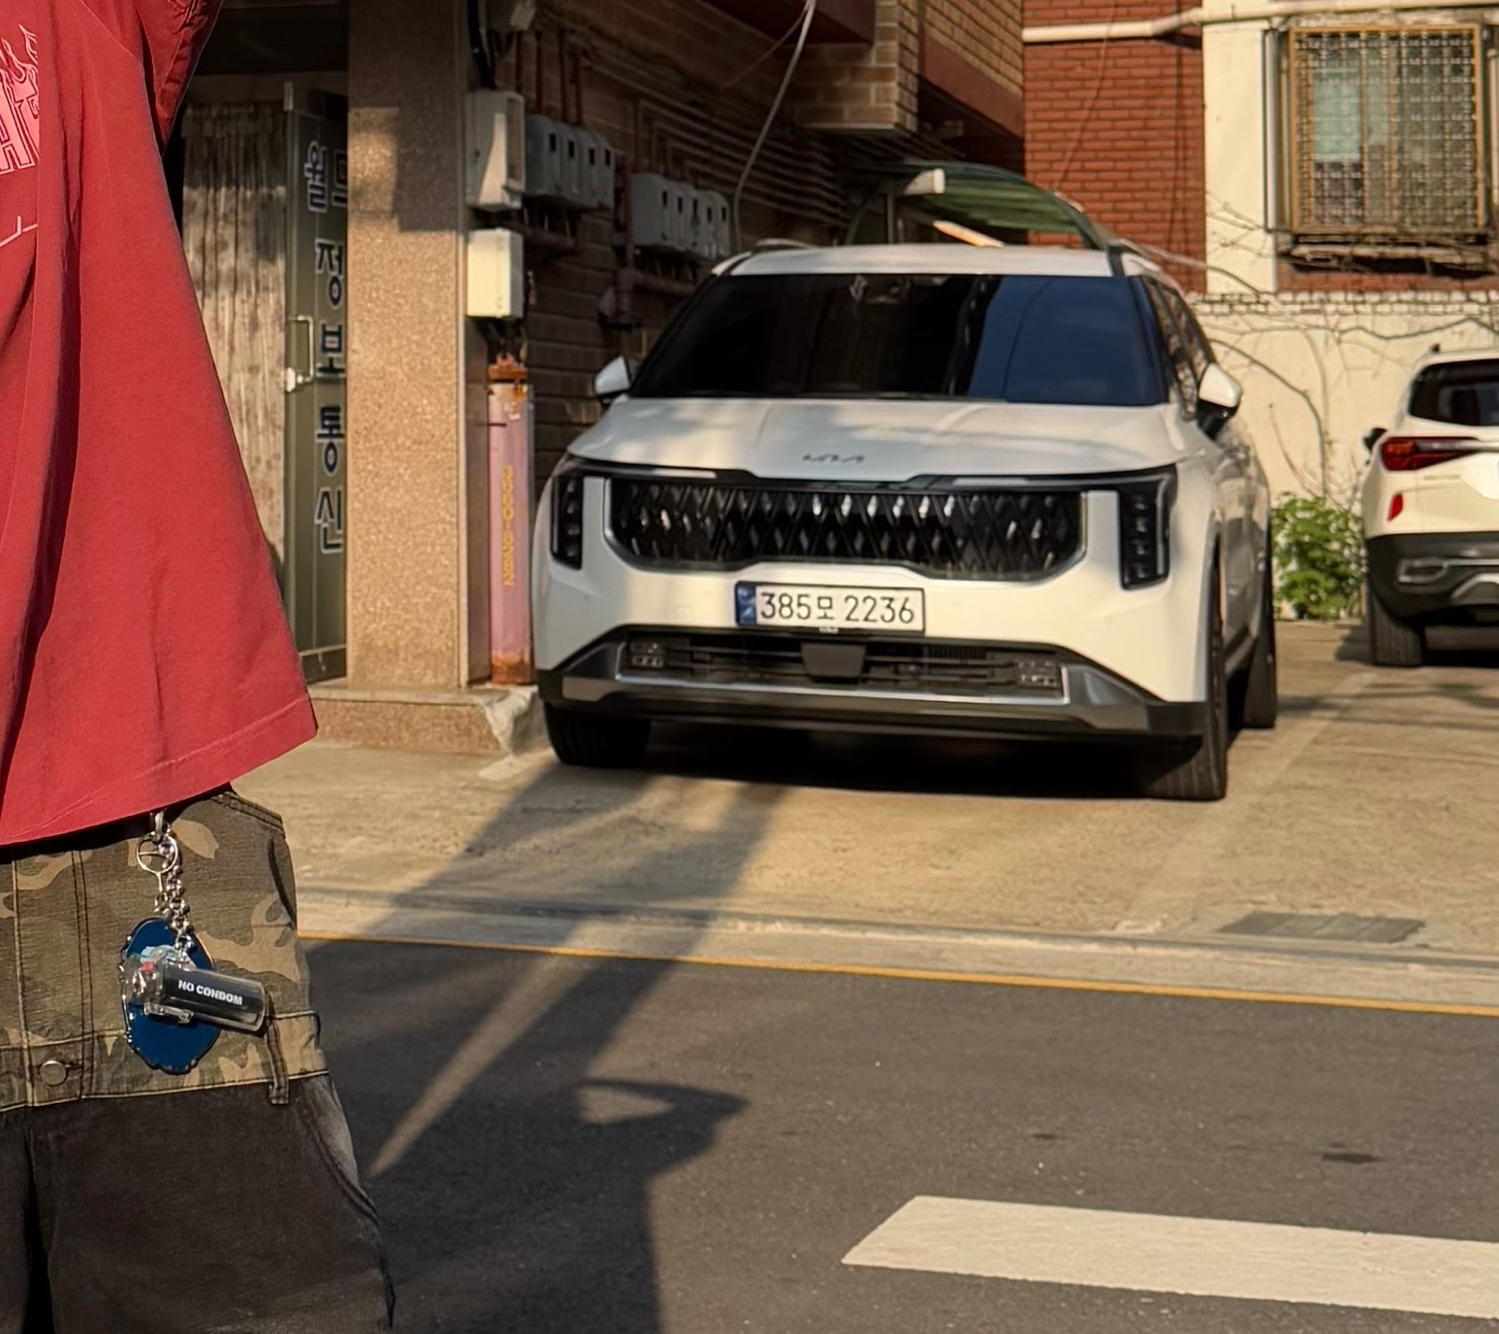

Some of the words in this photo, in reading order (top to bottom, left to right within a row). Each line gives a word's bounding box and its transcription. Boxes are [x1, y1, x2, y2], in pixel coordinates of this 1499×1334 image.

[760, 590, 835, 621] 385모
[844, 594, 915, 624] 2236
[178, 979, 195, 993] NO
[195, 984, 243, 1005] CONDOM
